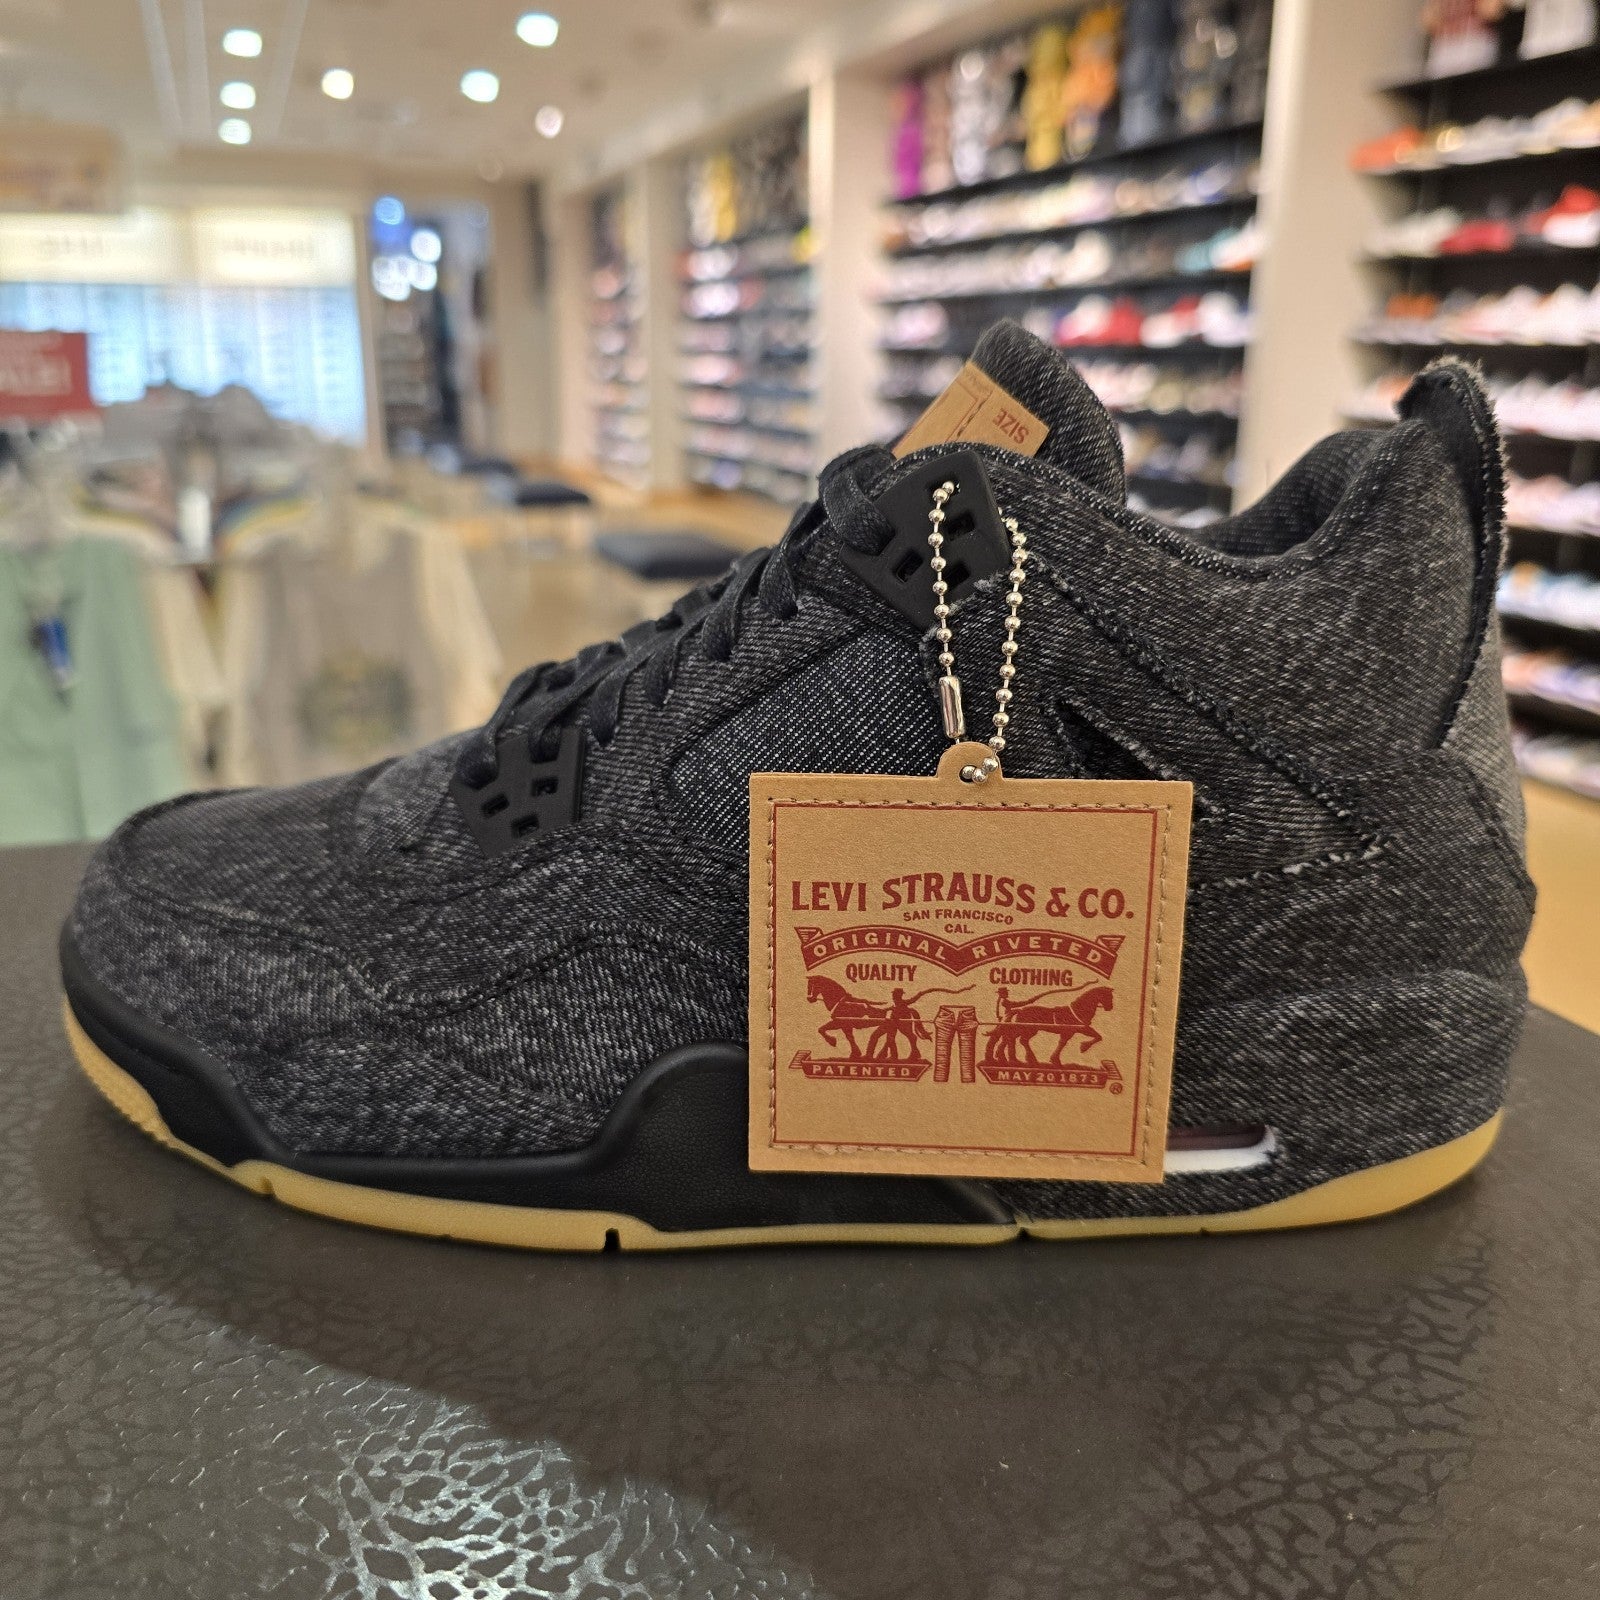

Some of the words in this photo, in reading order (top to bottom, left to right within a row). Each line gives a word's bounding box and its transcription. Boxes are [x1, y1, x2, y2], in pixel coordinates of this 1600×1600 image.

[992, 407, 1029, 444] SIZE
[792, 881, 867, 911] LEVI
[882, 872, 1036, 914] STRAUSS
[1045, 887, 1070, 917] &
[1078, 887, 1134, 919] CO.
[903, 910, 930, 921] SAN
[935, 909, 1014, 925] FRANCISCO
[944, 923, 974, 934] CAL.
[813, 932, 946, 961] ORIGINAL
[972, 936, 1101, 963] RIVETED
[845, 963, 917, 983] QUALITY
[989, 967, 1073, 986] CLOTHING
[812, 1064, 910, 1077] PATENTED
[998, 1070, 1032, 1082] MAY
[1036, 1071, 1055, 1083] 20
[1060, 1073, 1098, 1083] 1873
